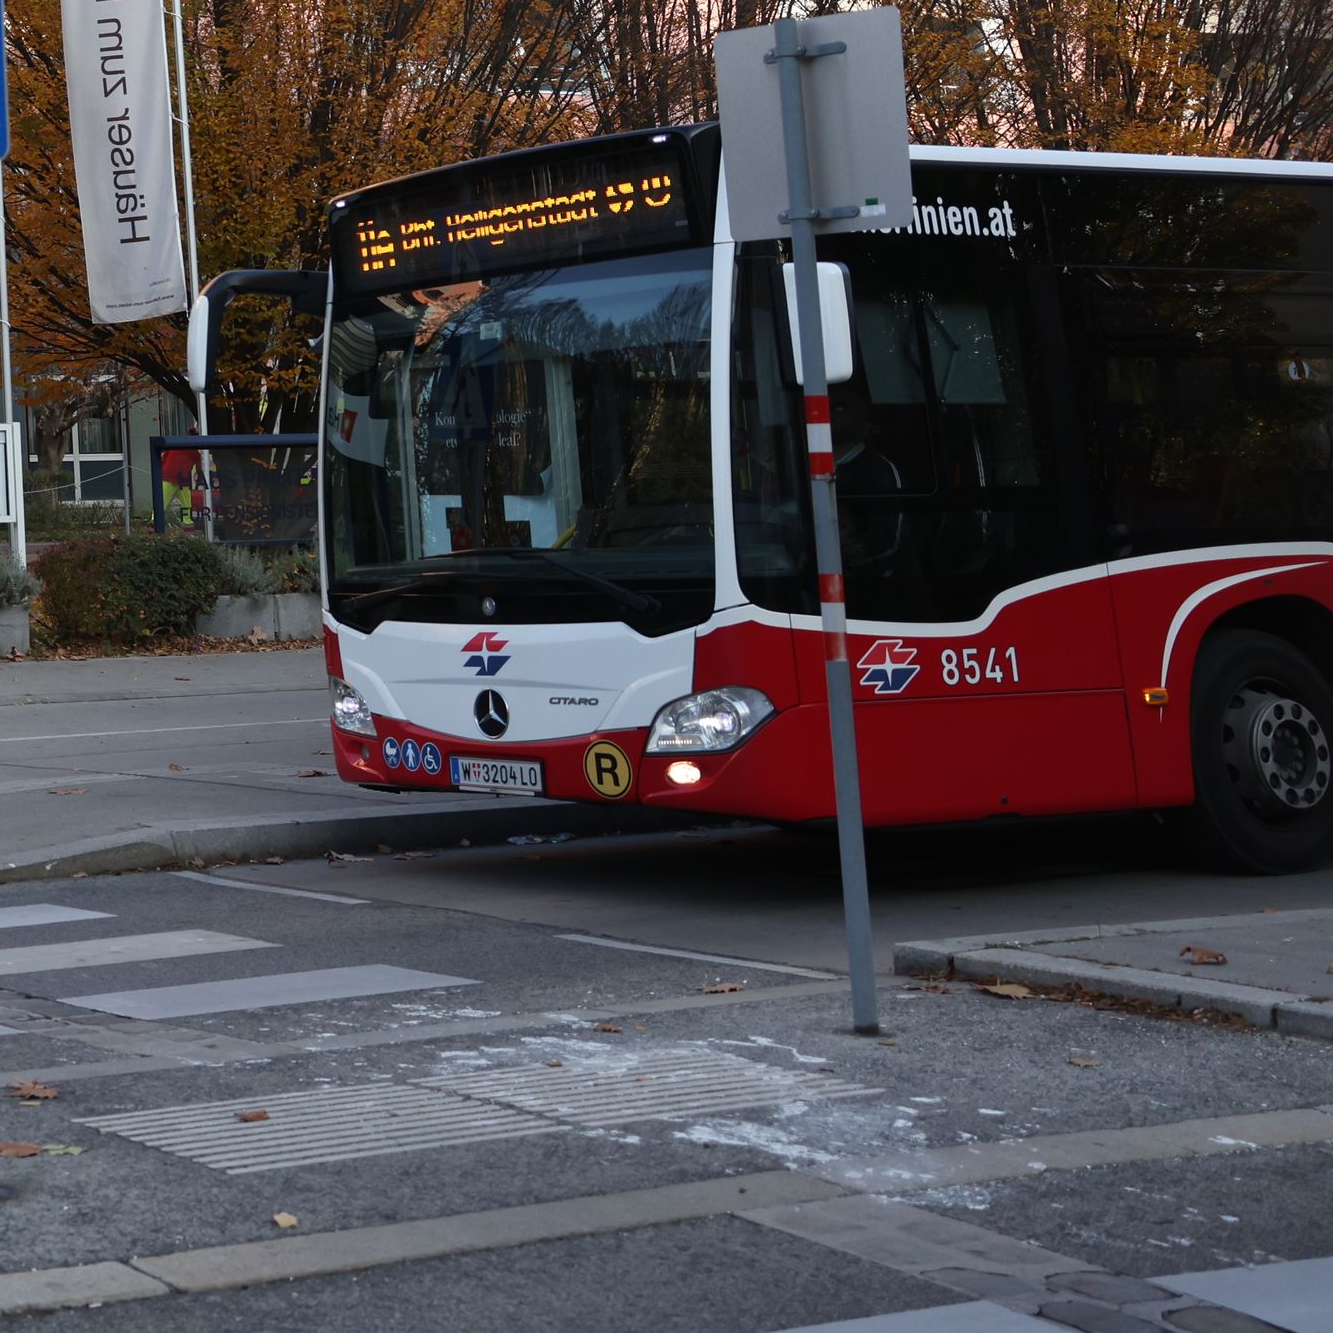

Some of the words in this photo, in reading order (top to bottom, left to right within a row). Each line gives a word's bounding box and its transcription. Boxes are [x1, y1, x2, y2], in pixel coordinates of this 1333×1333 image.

[941, 646, 1020, 686] 8541
[549, 696, 599, 706] CITARO
[461, 761, 473, 777] W
[594, 752, 621, 787] R
